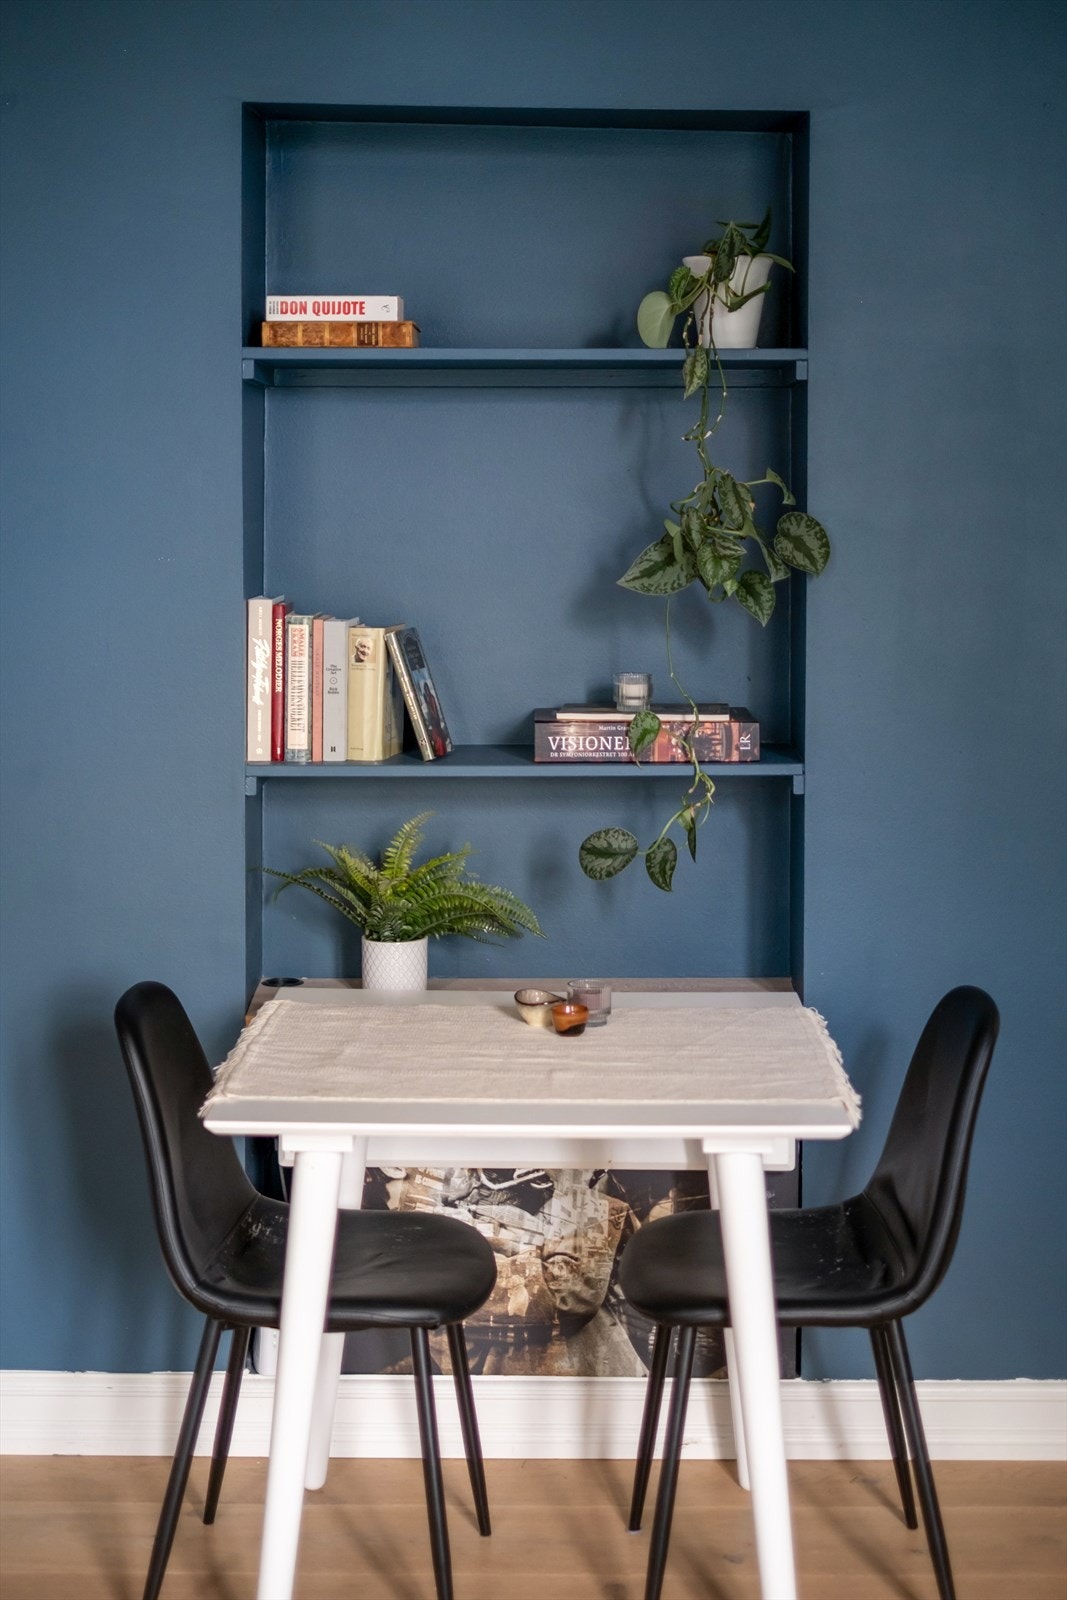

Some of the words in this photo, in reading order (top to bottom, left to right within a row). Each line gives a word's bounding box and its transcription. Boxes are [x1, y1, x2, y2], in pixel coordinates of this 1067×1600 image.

[280, 301, 307, 315] DON
[312, 301, 365, 316] QUIJOTE
[275, 618, 283, 651] NORGES
[275, 651, 283, 693] MELODIER
